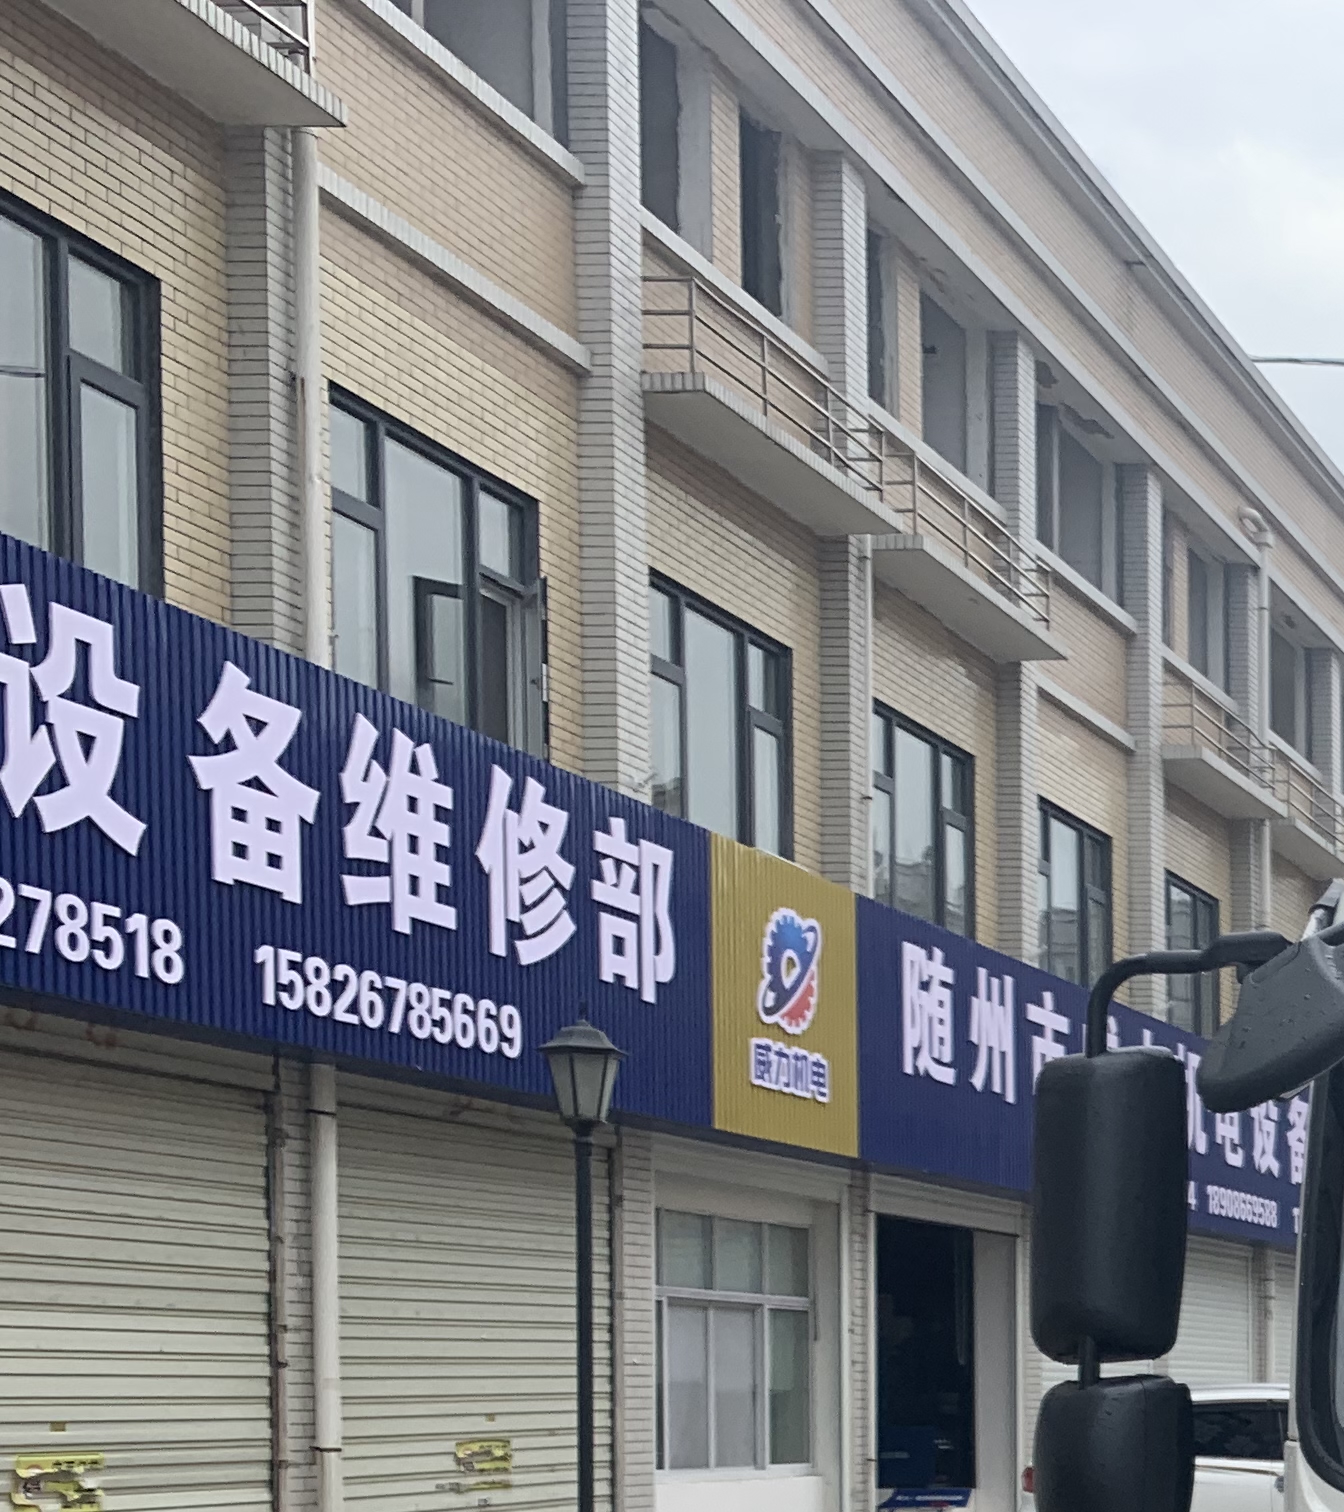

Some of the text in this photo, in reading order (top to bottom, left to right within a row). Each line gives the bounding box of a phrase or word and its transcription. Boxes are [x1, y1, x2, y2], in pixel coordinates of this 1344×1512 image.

[0, 583, 676, 1004] 设备维修部
[254, 944, 523, 1059] 15826785669
